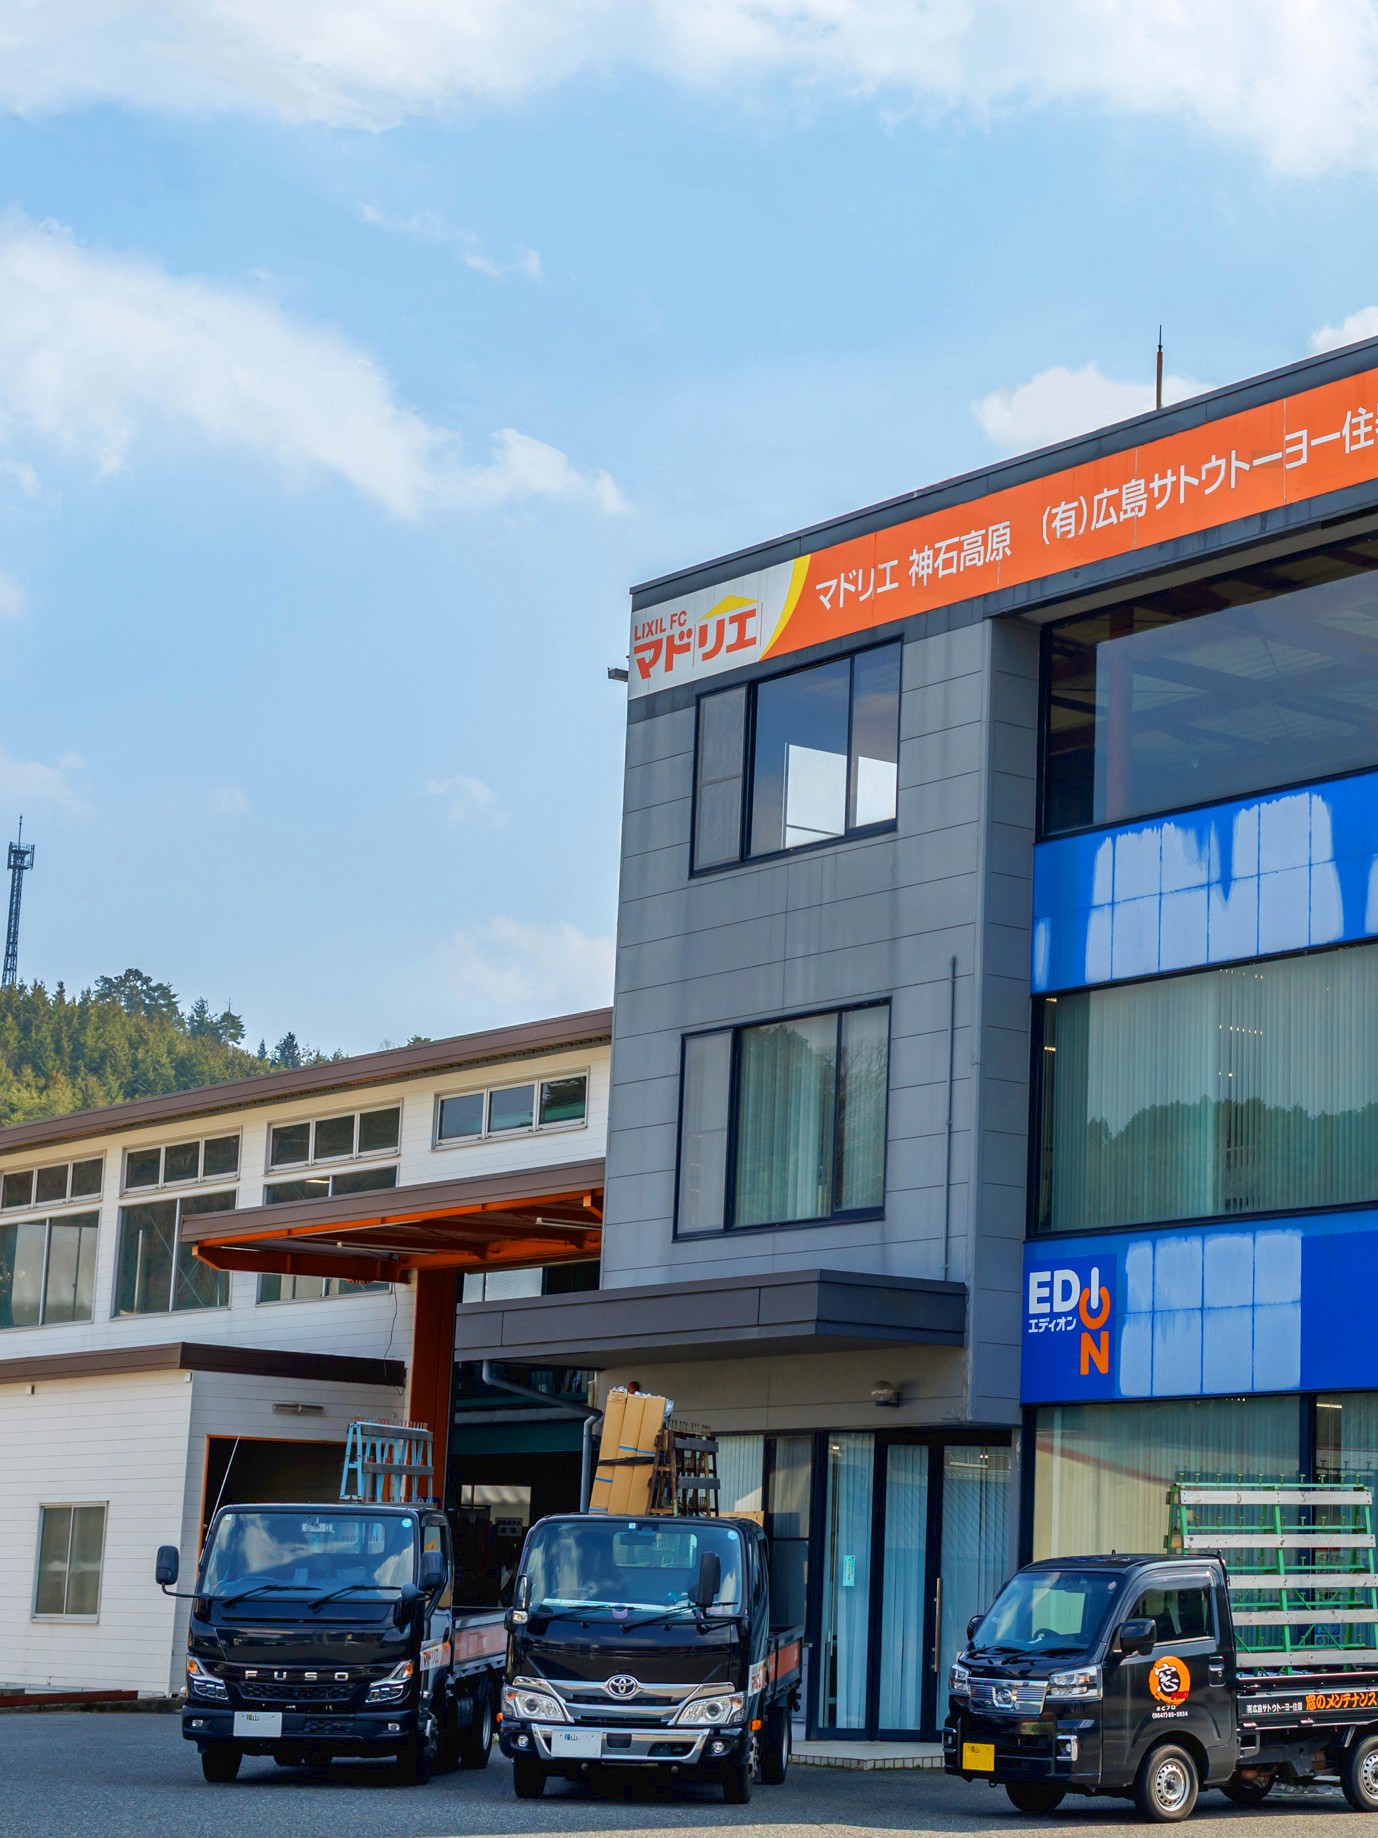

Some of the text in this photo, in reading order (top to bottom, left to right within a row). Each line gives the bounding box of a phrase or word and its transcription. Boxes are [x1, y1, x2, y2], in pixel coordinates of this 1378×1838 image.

[815, 560, 899, 610] マドリエ
[908, 522, 1011, 587] 神石高原
[634, 610, 687, 641] LIXIL FC
[633, 608, 756, 680] マドリエ
[1028, 1316, 1077, 1333] エディオン
[245, 1670, 349, 1681] FUSO
